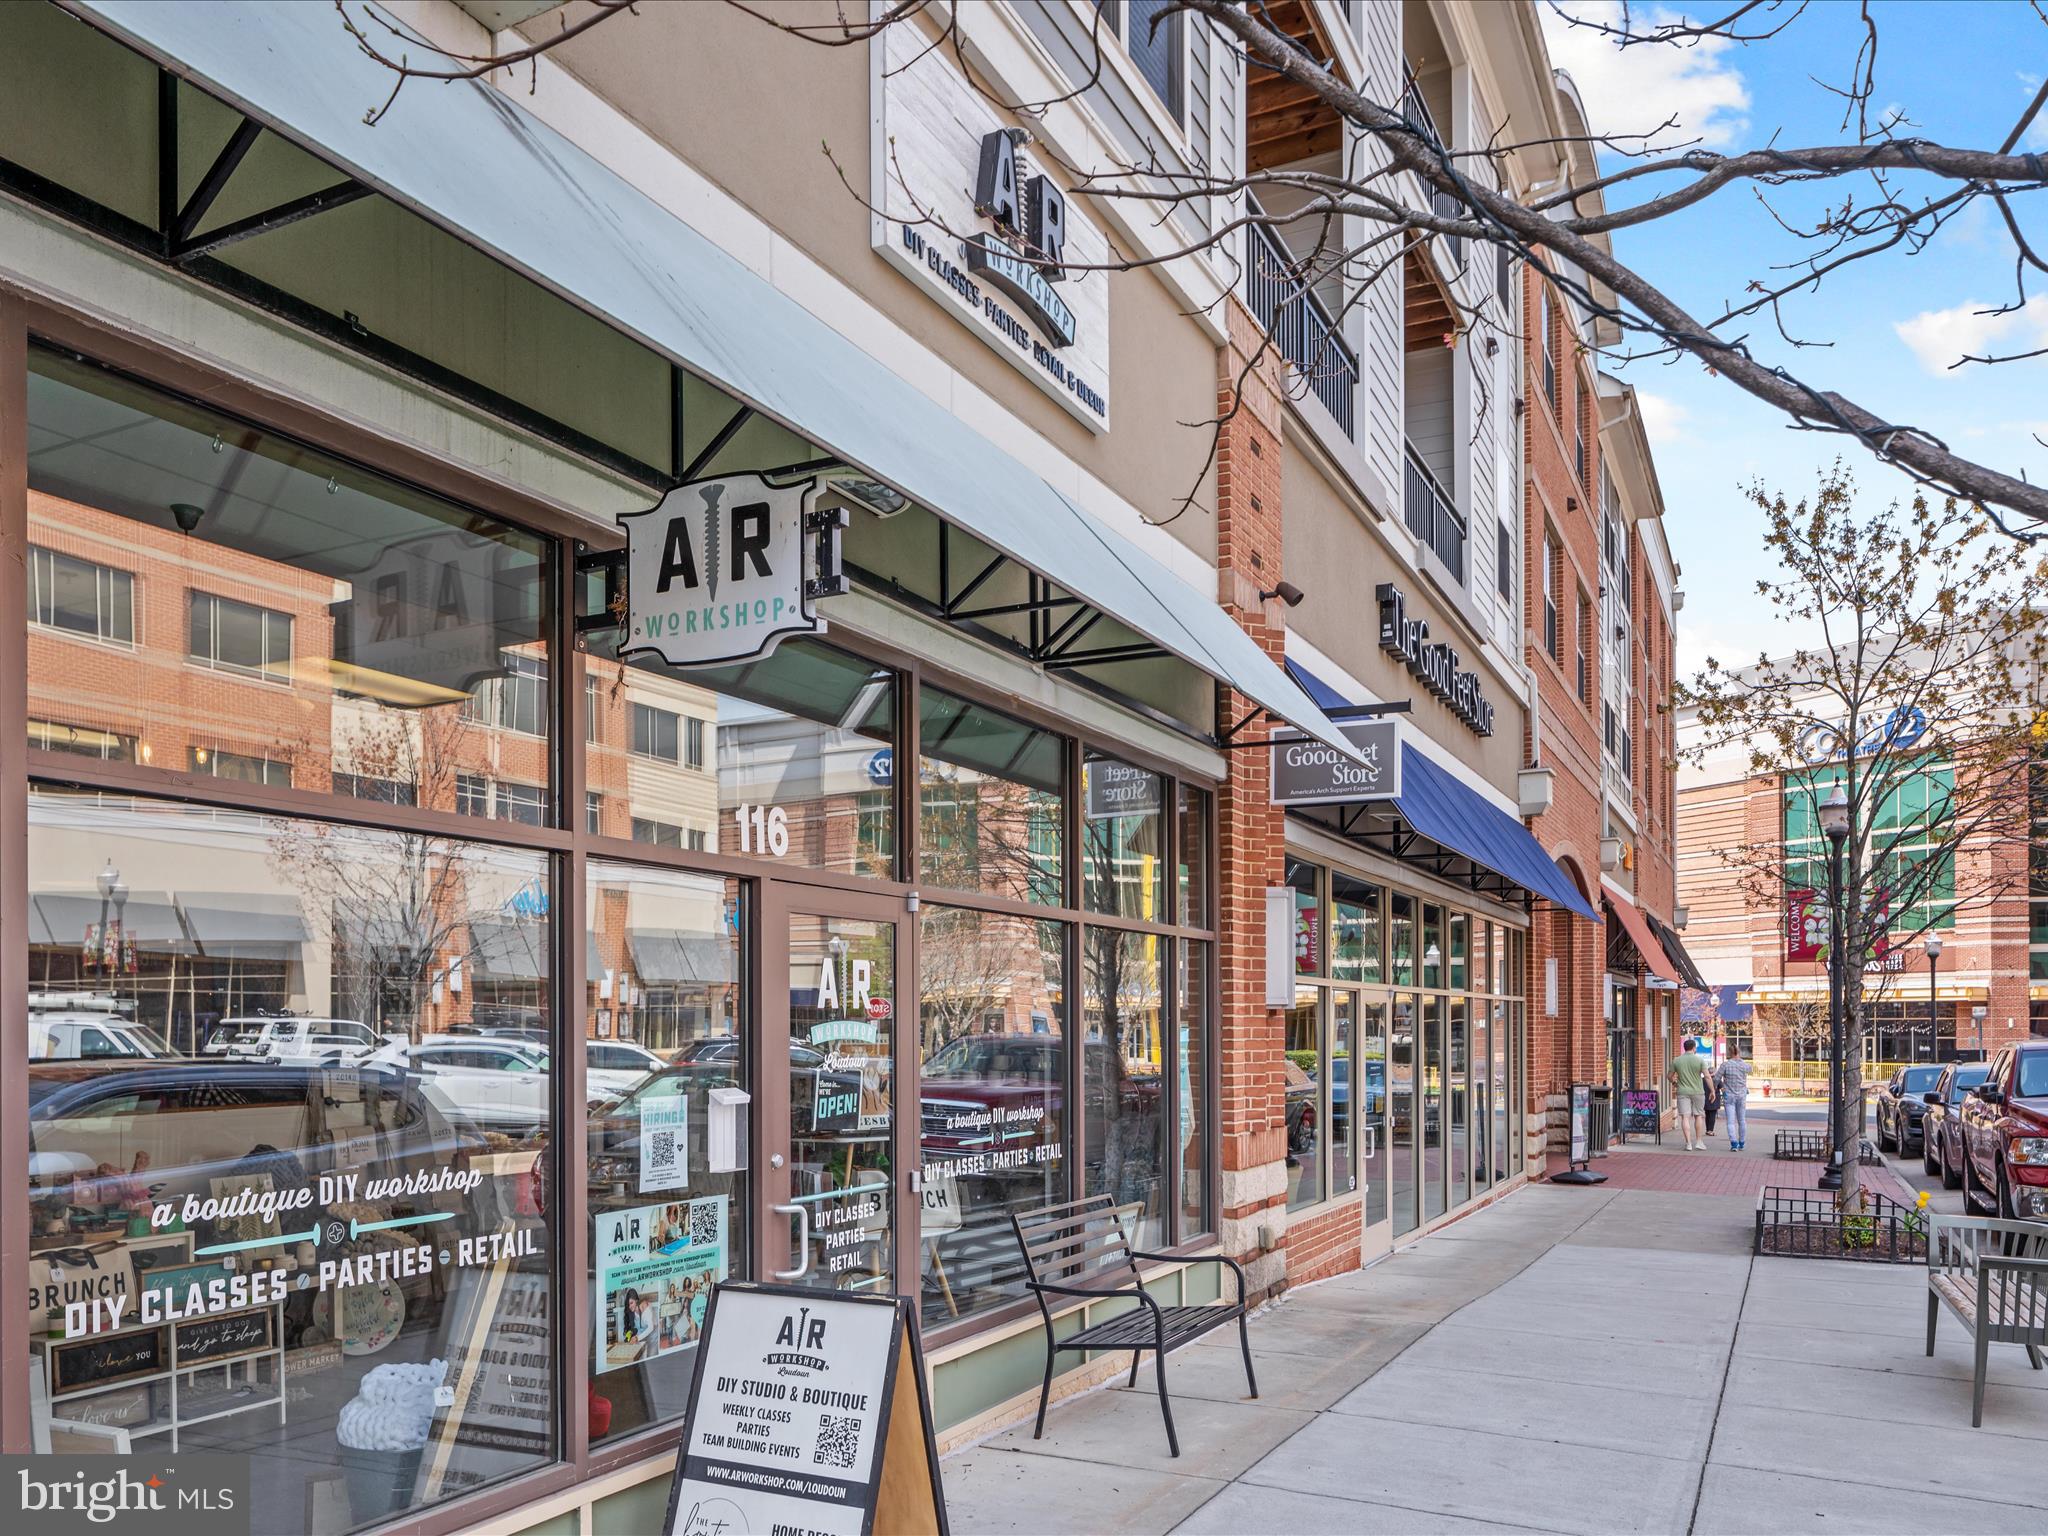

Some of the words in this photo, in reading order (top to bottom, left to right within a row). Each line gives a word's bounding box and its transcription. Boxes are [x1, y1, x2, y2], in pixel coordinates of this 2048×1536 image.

[989, 240, 1070, 332] WORKSHOP
[902, 224, 927, 259] DIY
[927, 246, 981, 307] CLASSES
[984, 296, 1030, 351] PARTIES
[1033, 339, 1066, 384] RETAIL
[1067, 371, 1076, 391] &
[1076, 378, 1106, 417] DECOR
[644, 597, 785, 640] WORKSHOP
[1382, 584, 1417, 662] The
[1418, 619, 1451, 697] Good
[1451, 650, 1473, 718] Feet
[1472, 673, 1496, 737] Store
[1332, 763, 1380, 785] Store
[1330, 786, 1353, 794] Support
[736, 803, 789, 856] 116
[815, 1022, 875, 1040] WORKSHOP
[823, 1053, 866, 1074] Loudoun
[818, 1093, 858, 1119] OPEN!
[1626, 1101, 1657, 1110] TACO
[643, 1111, 678, 1127] HIRING
[946, 1118, 955, 1130] a
[954, 1110, 993, 1132] boutique
[992, 1106, 1006, 1124] DIY
[1006, 1105, 1045, 1125] workshop
[924, 1161, 943, 1182] DIY
[944, 1153, 985, 1179] CLASSES
[993, 1148, 1028, 1170] PARTIES
[1035, 1142, 1063, 1163] RETAIL
[151, 1202, 177, 1227] a
[181, 1187, 315, 1224] boutique
[319, 1174, 359, 1206] DIY
[365, 1166, 484, 1201] workshop
[815, 1210, 833, 1229] DIY
[834, 1202, 875, 1225] CLASSES
[826, 1226, 866, 1250] PARTIES
[829, 1251, 863, 1273] RETAIL
[29, 1271, 126, 1311] BRUNCH
[65, 1294, 128, 1339] DIY
[141, 1269, 288, 1325] CLASSES
[319, 1244, 433, 1292] PARTIES
[458, 1228, 538, 1267] RETAIL
[177, 1337, 201, 1351] and
[199, 1337, 218, 1353] go
[221, 1328, 236, 1342] to
[235, 1325, 263, 1343] sleep
[190, 1327, 209, 1336] GIVE
[210, 1325, 219, 1333] IT
[222, 1321, 232, 1330] TO
[234, 1319, 250, 1328] GOD
[135, 1350, 151, 1361] YOU
[308, 1353, 340, 1368] MARKET
[770, 1353, 823, 1369] WORKSHOP
[777, 1367, 811, 1378] Loudoun
[717, 1376, 739, 1393] DIY
[740, 1379, 787, 1401] STUDIO
[789, 1386, 799, 1401] &
[802, 1387, 869, 1412] BOUTIQUE
[722, 1403, 755, 1418] WEEKLY
[757, 1407, 792, 1424] CLASSES
[736, 1421, 771, 1437] PARTIES
[702, 1432, 725, 1448] TEAM
[726, 1436, 767, 1454] BUILDING
[768, 1443, 801, 1459] EVENTS
[706, 1464, 847, 1500] WWW.ARWORKSHOP.COM/LOUDOUN
[695, 1517, 709, 1527] THE
[771, 1523, 805, 1536] HOME
